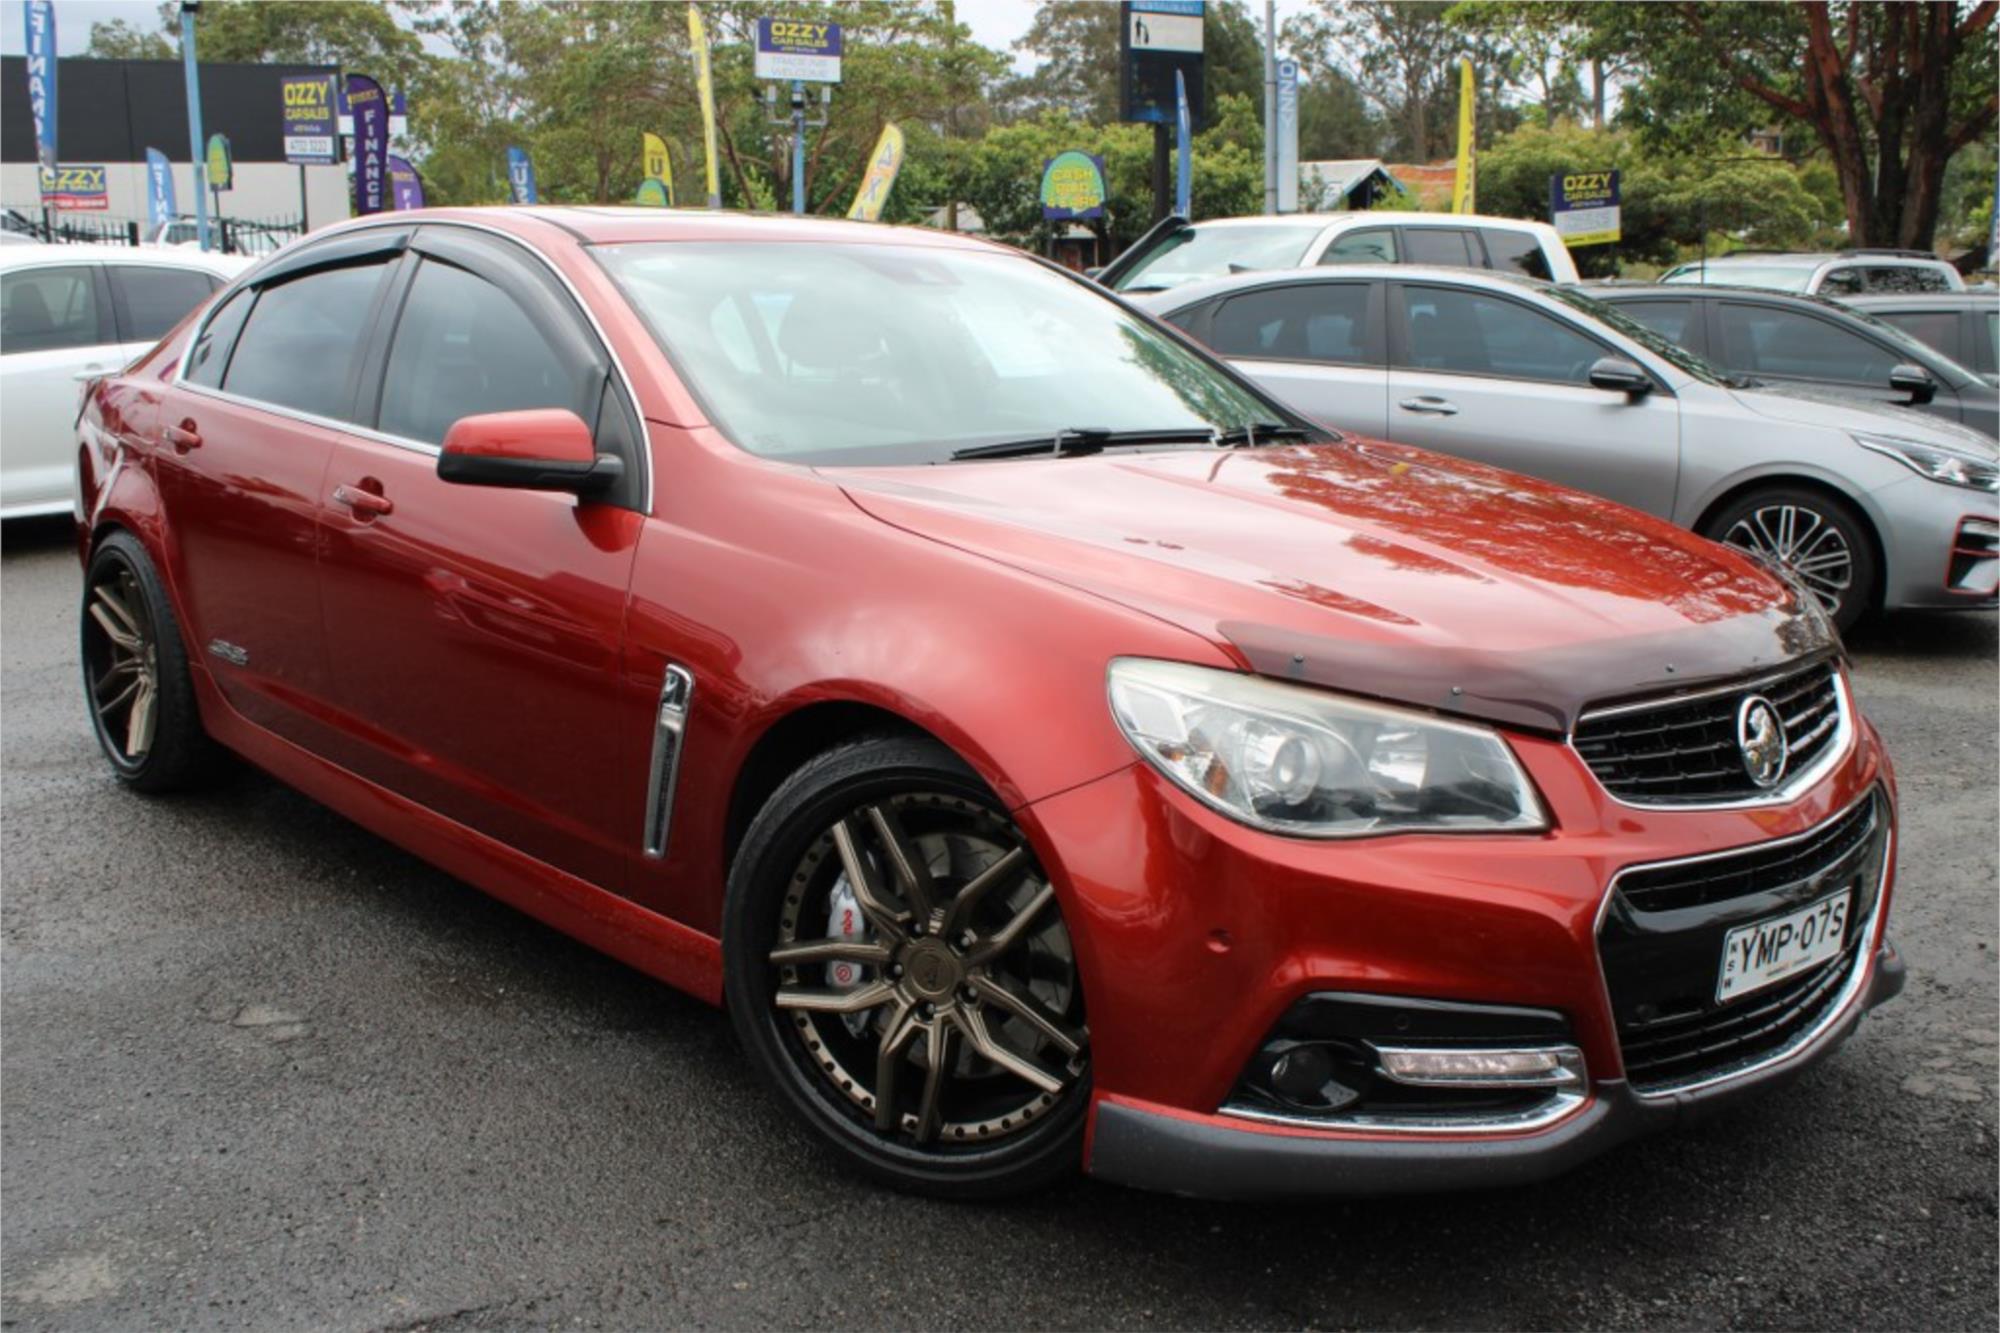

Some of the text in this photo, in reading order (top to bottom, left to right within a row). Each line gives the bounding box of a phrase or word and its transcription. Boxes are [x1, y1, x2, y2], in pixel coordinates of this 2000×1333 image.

[771, 22, 827, 38] OZZY
[284, 82, 328, 105] OZZY
[364, 110, 380, 208] FINANCE
[1563, 173, 1612, 191] OZZY
